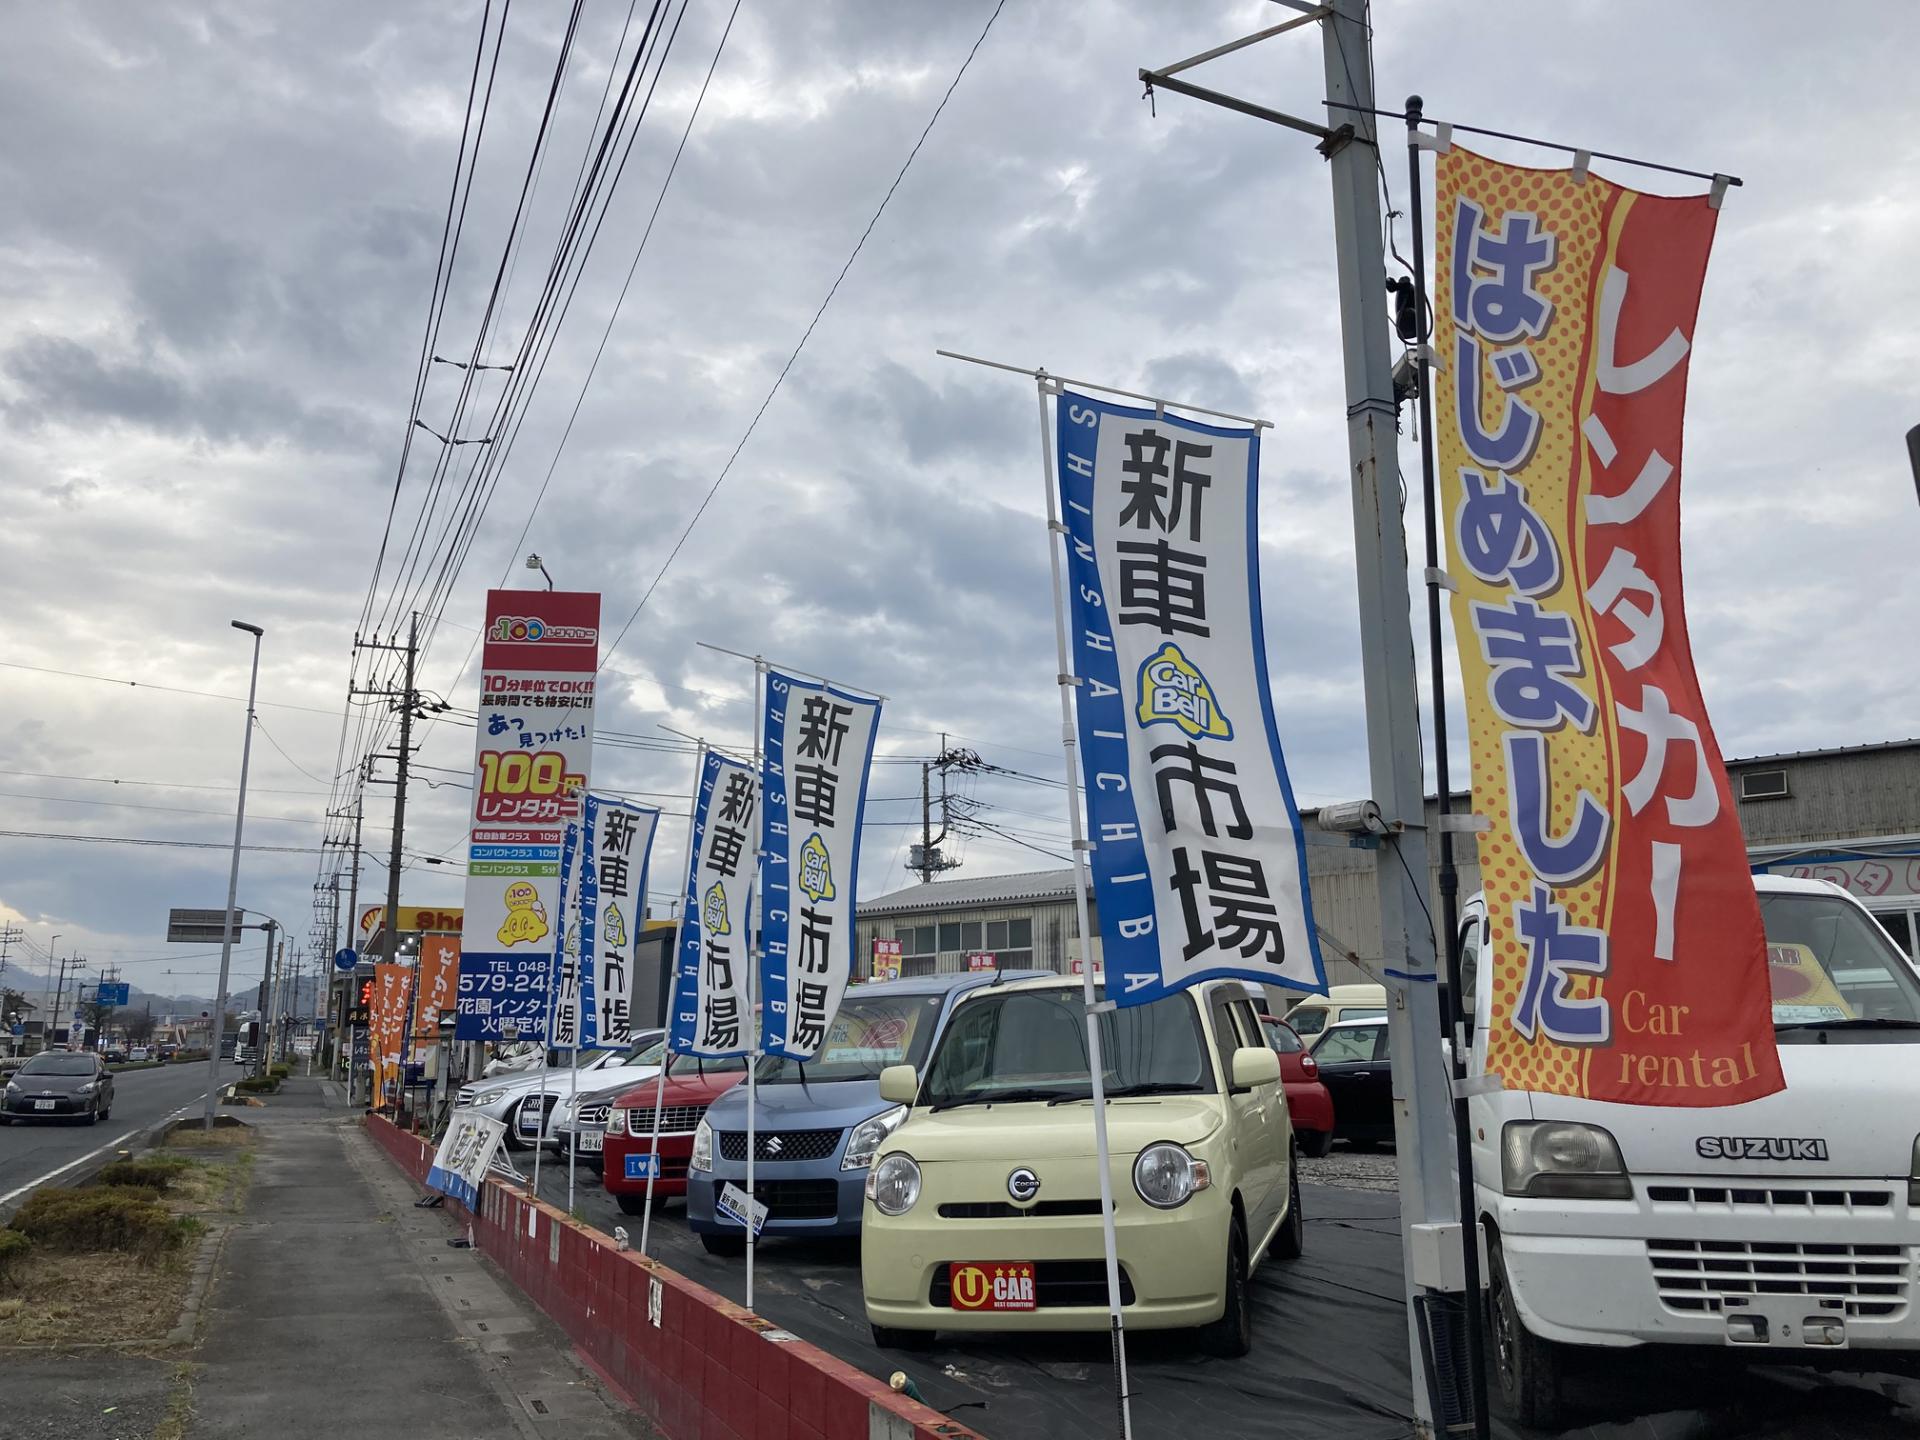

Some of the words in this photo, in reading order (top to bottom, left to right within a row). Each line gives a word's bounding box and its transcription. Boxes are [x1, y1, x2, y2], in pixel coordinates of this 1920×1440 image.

[1117, 429, 1212, 638] 新車
[1452, 197, 1609, 1041] はじめました
[1581, 264, 1720, 961] レンタカー
[1067, 404, 1160, 994] SHINSHAICHIBA
[1150, 662, 1202, 693] Car
[481, 694, 593, 709] 長時間でも格安に!!
[1153, 688, 1211, 728] Bell
[488, 713, 525, 736] あっ
[519, 725, 587, 748] 見つけた!
[482, 753, 584, 795] 100円
[794, 695, 853, 829] 新車
[481, 797, 581, 819] レンタカー
[705, 772, 763, 878] 新車
[600, 809, 641, 899] 新車
[768, 679, 790, 1048] SHINSHAICHIBA
[804, 848, 827, 868] Car
[1150, 741, 1286, 965] 市場
[708, 892, 723, 911] Car
[804, 869, 828, 893] Bell
[458, 973, 549, 993] 579-24
[488, 961, 514, 972] TEL
[792, 906, 833, 1051] 市場
[602, 950, 632, 1044] 市場
[702, 939, 739, 1050] 市場
[1621, 990, 1690, 1036] Car
[1617, 1043, 1761, 1089] rental
[1696, 1136, 1829, 1161] SUZUKI
[993, 1276, 1033, 1301] CAR
